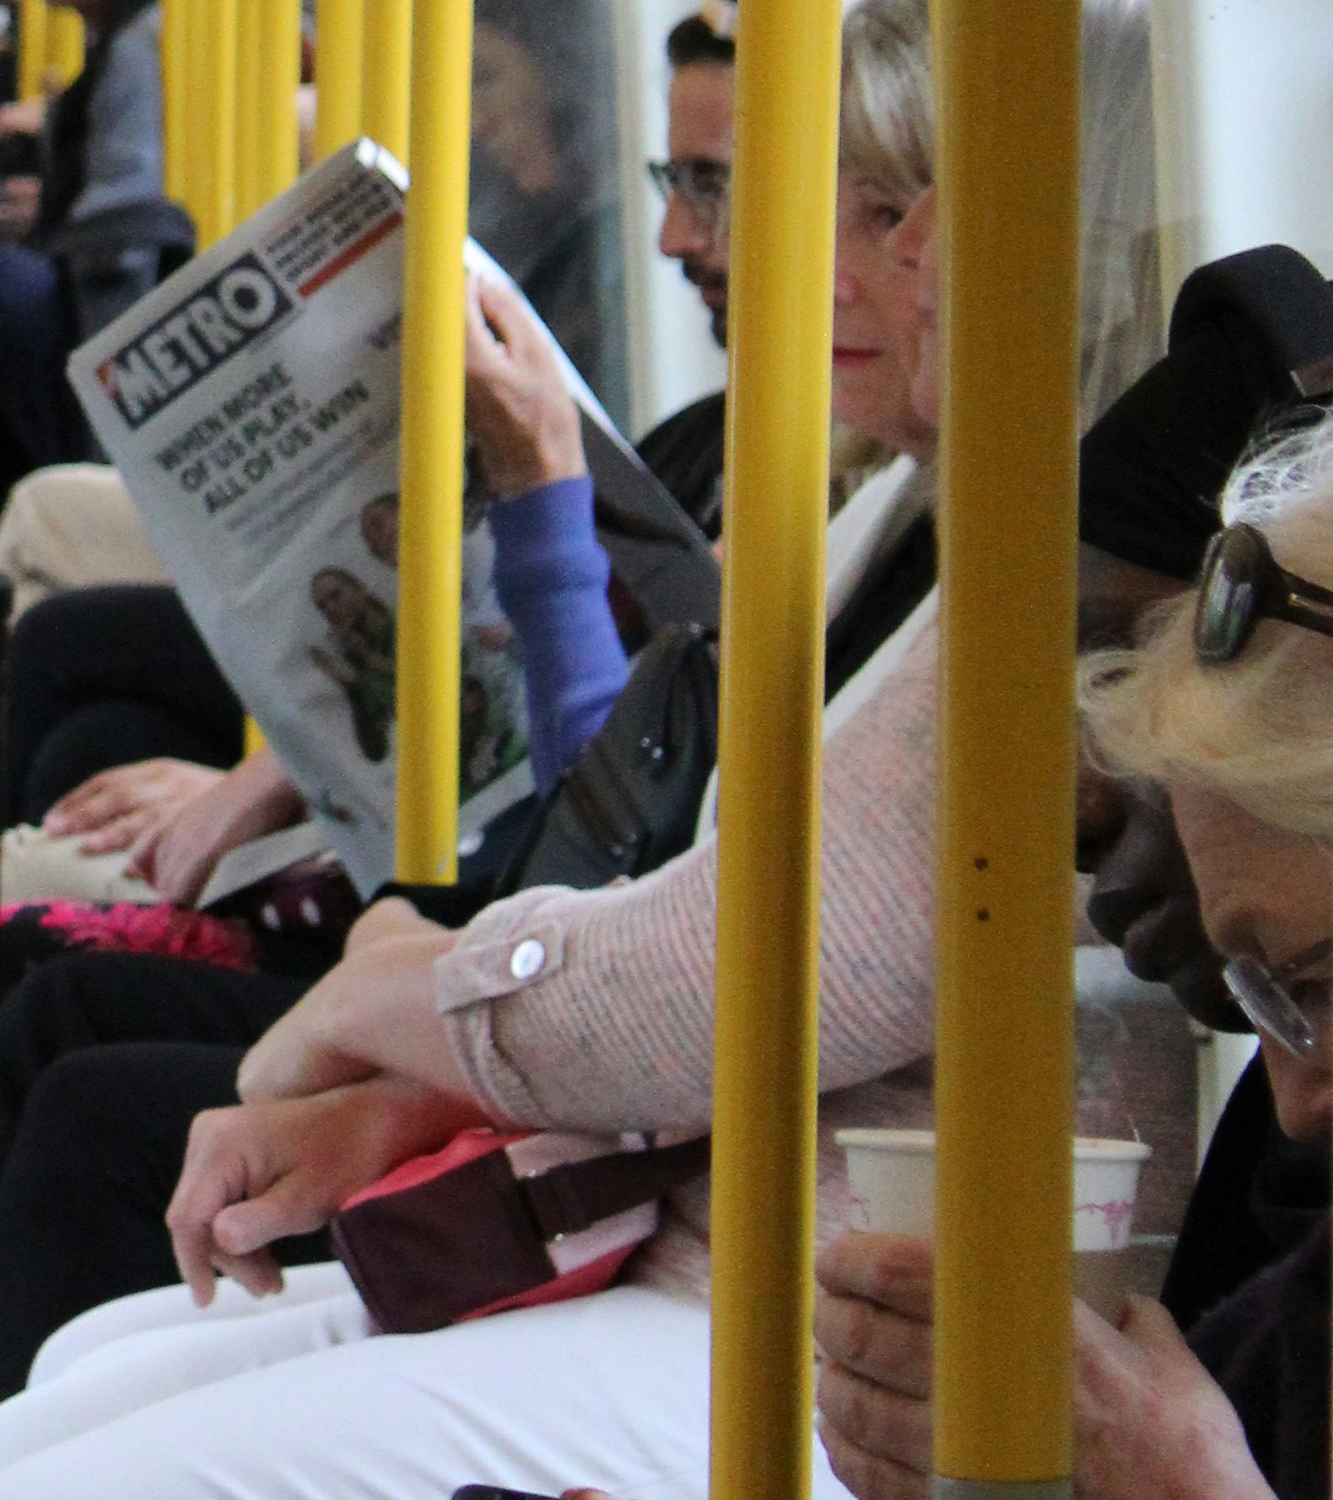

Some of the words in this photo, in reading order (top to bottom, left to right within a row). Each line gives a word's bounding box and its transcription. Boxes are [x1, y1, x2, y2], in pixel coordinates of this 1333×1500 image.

[111, 266, 279, 418] METRO
[153, 411, 225, 471] WHEN
[222, 361, 292, 422] MORE
[181, 456, 211, 493] OF
[206, 436, 246, 471] US
[202, 472, 247, 515] ALL
[243, 447, 274, 484] OF
[276, 425, 314, 459] US
[309, 378, 370, 432] WIN
